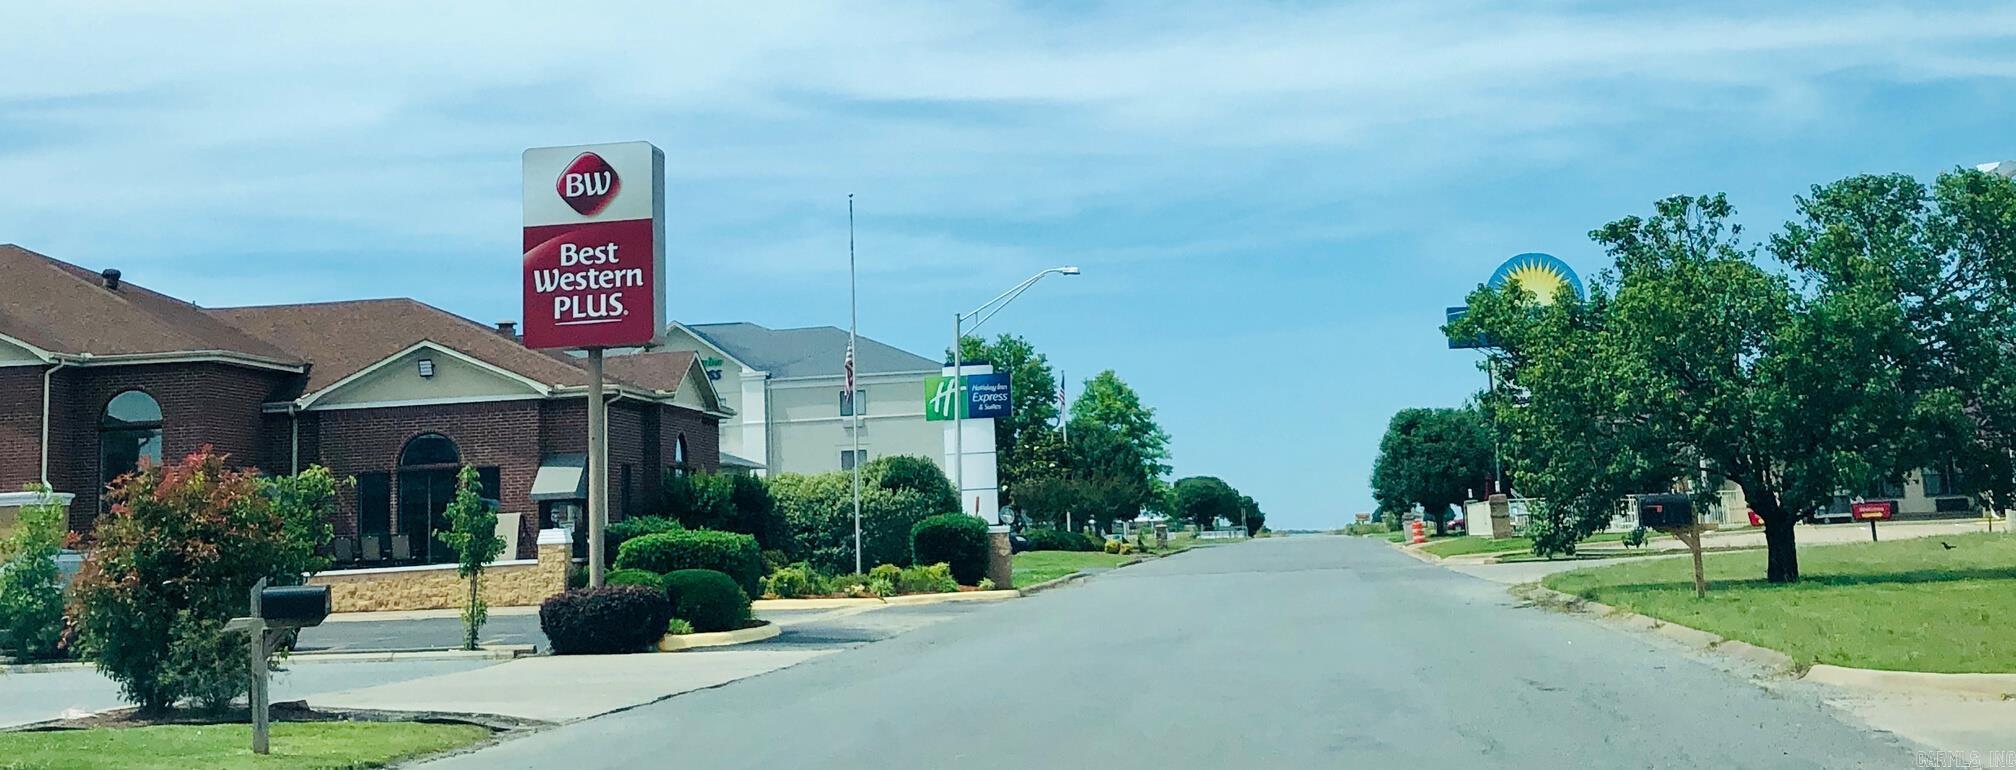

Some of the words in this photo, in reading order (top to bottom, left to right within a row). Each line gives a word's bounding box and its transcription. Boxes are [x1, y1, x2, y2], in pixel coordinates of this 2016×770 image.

[565, 171, 612, 198] BW
[560, 243, 619, 267] Best
[533, 268, 644, 293] Western
[972, 392, 1008, 403] Express
[997, 383, 1008, 391] Inn
